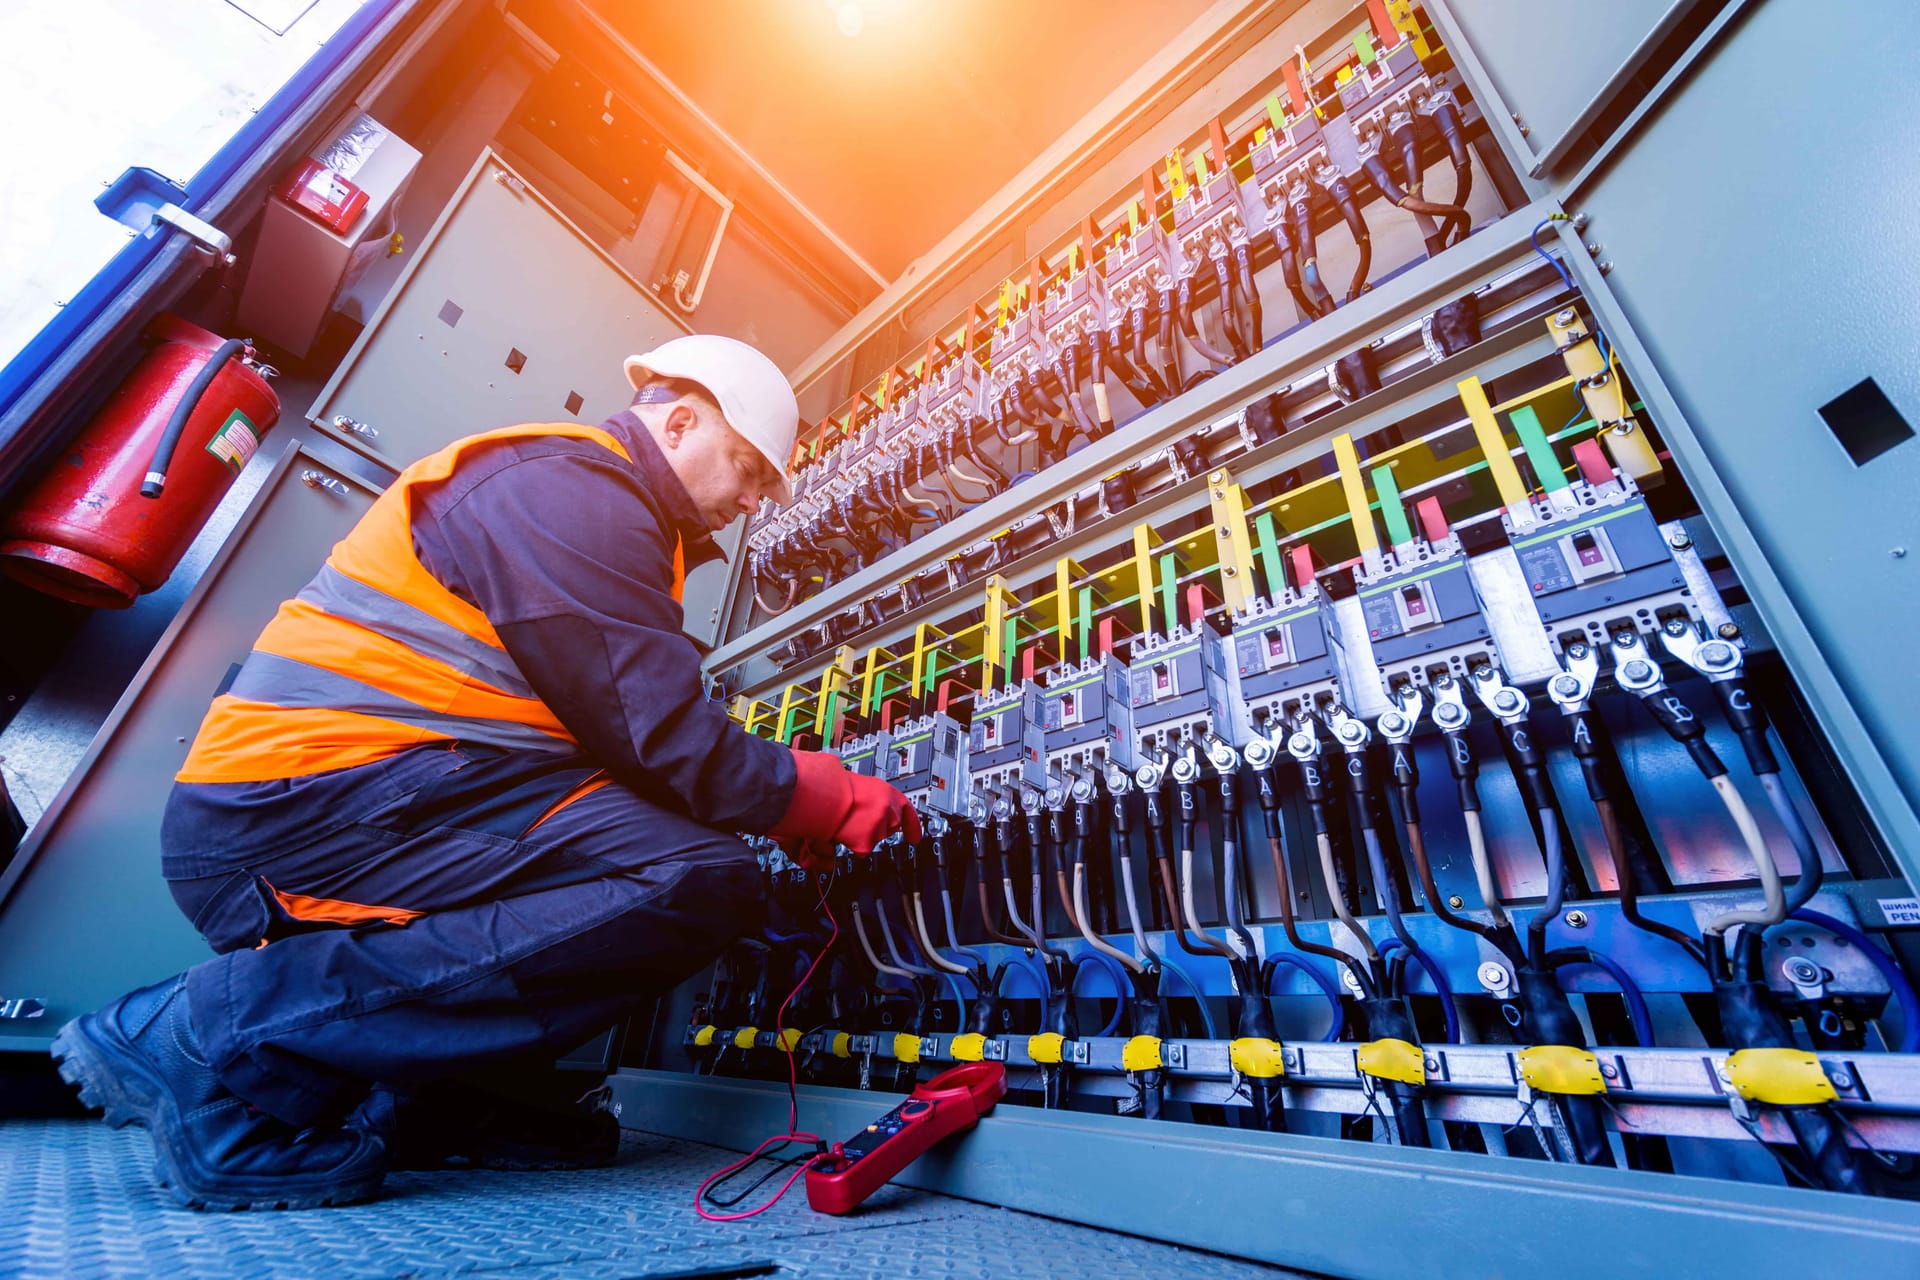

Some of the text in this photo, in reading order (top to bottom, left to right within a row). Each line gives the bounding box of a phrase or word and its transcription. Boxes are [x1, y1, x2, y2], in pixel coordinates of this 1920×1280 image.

[1336, 183, 1347, 193] C
[1296, 202, 1308, 216] B
[1277, 228, 1288, 244] A
[1216, 262, 1227, 276] B
[1133, 311, 1141, 325] B
[1730, 689, 1752, 710] C
[1663, 697, 1694, 723] B
[1574, 718, 1592, 744] A
[1512, 730, 1530, 752] C
[1454, 737, 1471, 764] B
[1347, 758, 1362, 776] C
[1394, 750, 1413, 776] A
[1306, 766, 1321, 786] B
[1221, 782, 1232, 796] C
[1260, 776, 1273, 796] A
[1147, 798, 1158, 818] A
[1181, 791, 1194, 810] B
[1075, 810, 1083, 825] B
[1114, 803, 1121, 818] C
[996, 827, 1003, 841] B
[1050, 819, 1057, 837] A
[973, 832, 979, 849] A
[1891, 912, 1920, 921] PEN
